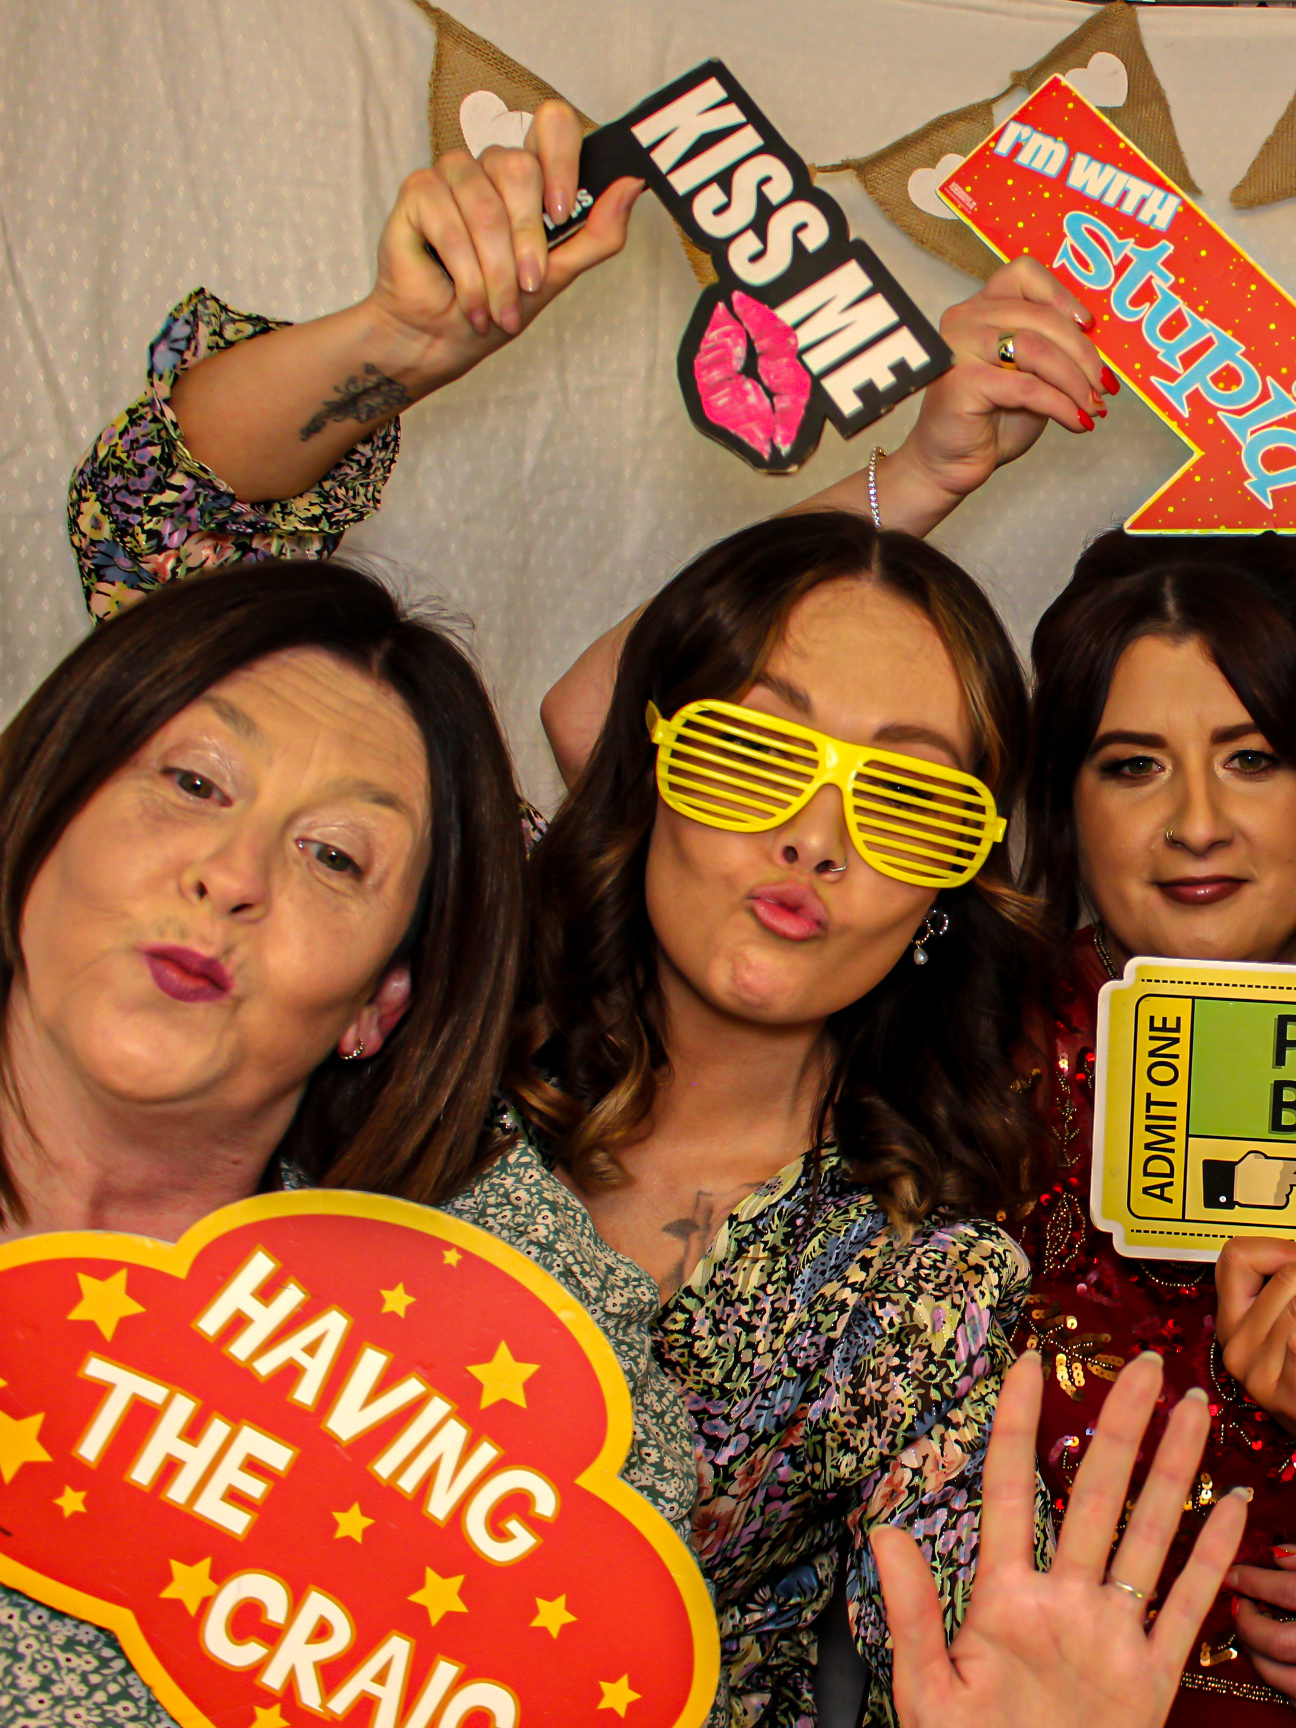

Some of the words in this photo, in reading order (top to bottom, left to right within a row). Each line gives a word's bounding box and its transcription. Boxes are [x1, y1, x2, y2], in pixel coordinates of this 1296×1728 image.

[631, 77, 829, 286] KISS
[774, 259, 930, 418] ME
[1067, 154, 1181, 231] WITH
[1147, 1015, 1181, 1087] ONE
[1143, 1093, 1180, 1203] ADMIT
[71, 1352, 299, 1540] THE
[191, 1243, 560, 1565] HAVING
